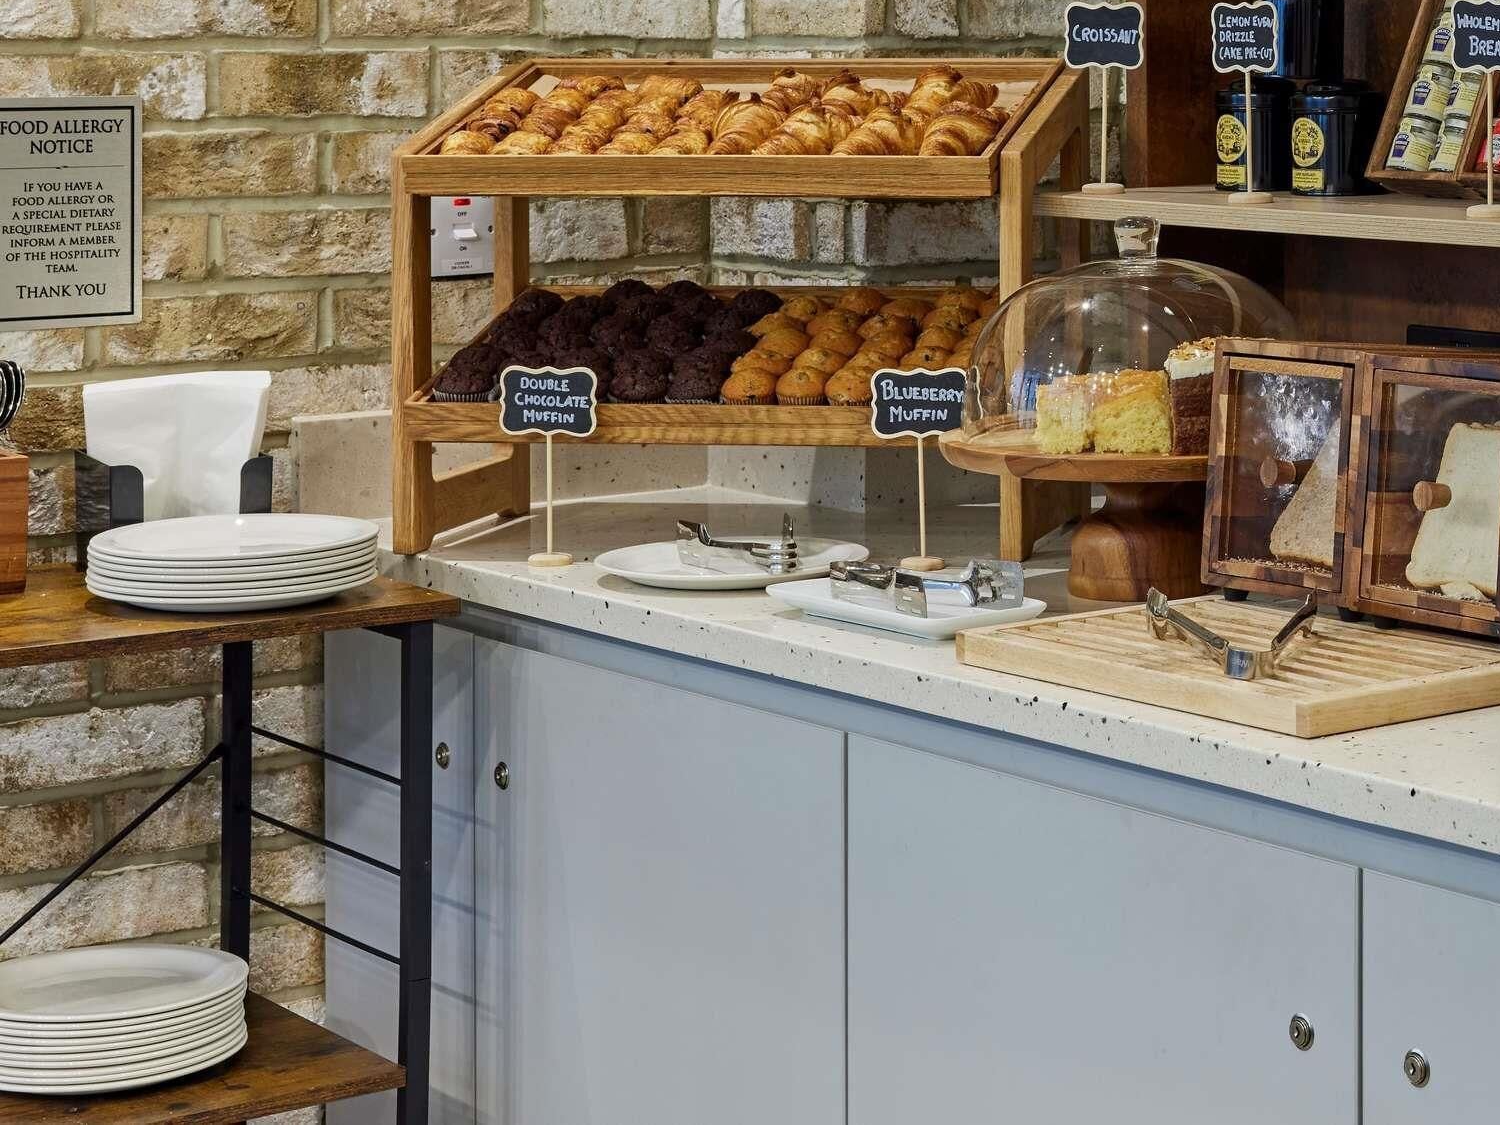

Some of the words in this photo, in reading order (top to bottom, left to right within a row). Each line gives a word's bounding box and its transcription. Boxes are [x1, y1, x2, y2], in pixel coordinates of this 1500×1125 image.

[1219, 13, 1251, 28] LEMON
[1072, 24, 1139, 46] CROISSANT
[1220, 30, 1256, 43] DRIZZLE
[1220, 47, 1243, 60] CAKE
[1245, 47, 1273, 61] PRE-CUT
[0, 121, 49, 135] FOOD
[53, 119, 124, 134] ALLERGY
[30, 139, 94, 154] NOTICE
[24, 183, 34, 192] IF
[37, 183, 60, 192] YOU
[65, 182, 93, 191] HAVE
[96, 181, 103, 191] A
[12, 197, 45, 206] FOOD
[48, 195, 95, 205] ALLERGY
[98, 195, 114, 204] OR
[12, 211, 20, 220] A
[23, 210, 67, 220] SPECIAL
[70, 208, 115, 218] DIETARY
[2, 222, 82, 235] REQUIREMENT
[86, 221, 121, 231] PLEASE
[10, 238, 55, 248] INFORM
[59, 237, 66, 246] A
[70, 235, 116, 245] MEMBER
[6, 253, 20, 262] OF
[24, 252, 46, 261] THE
[50, 249, 121, 260] HOSPITALITY
[45, 264, 78, 273] TEAM.
[16, 285, 71, 299] THANK
[75, 283, 106, 296] YOU
[520, 376, 570, 392] DOUBLE
[880, 379, 964, 403] BLUEBERRY
[514, 392, 590, 409] CHOCOLATE
[523, 409, 575, 423] MUFFIN
[889, 406, 948, 423] MUFFIN
